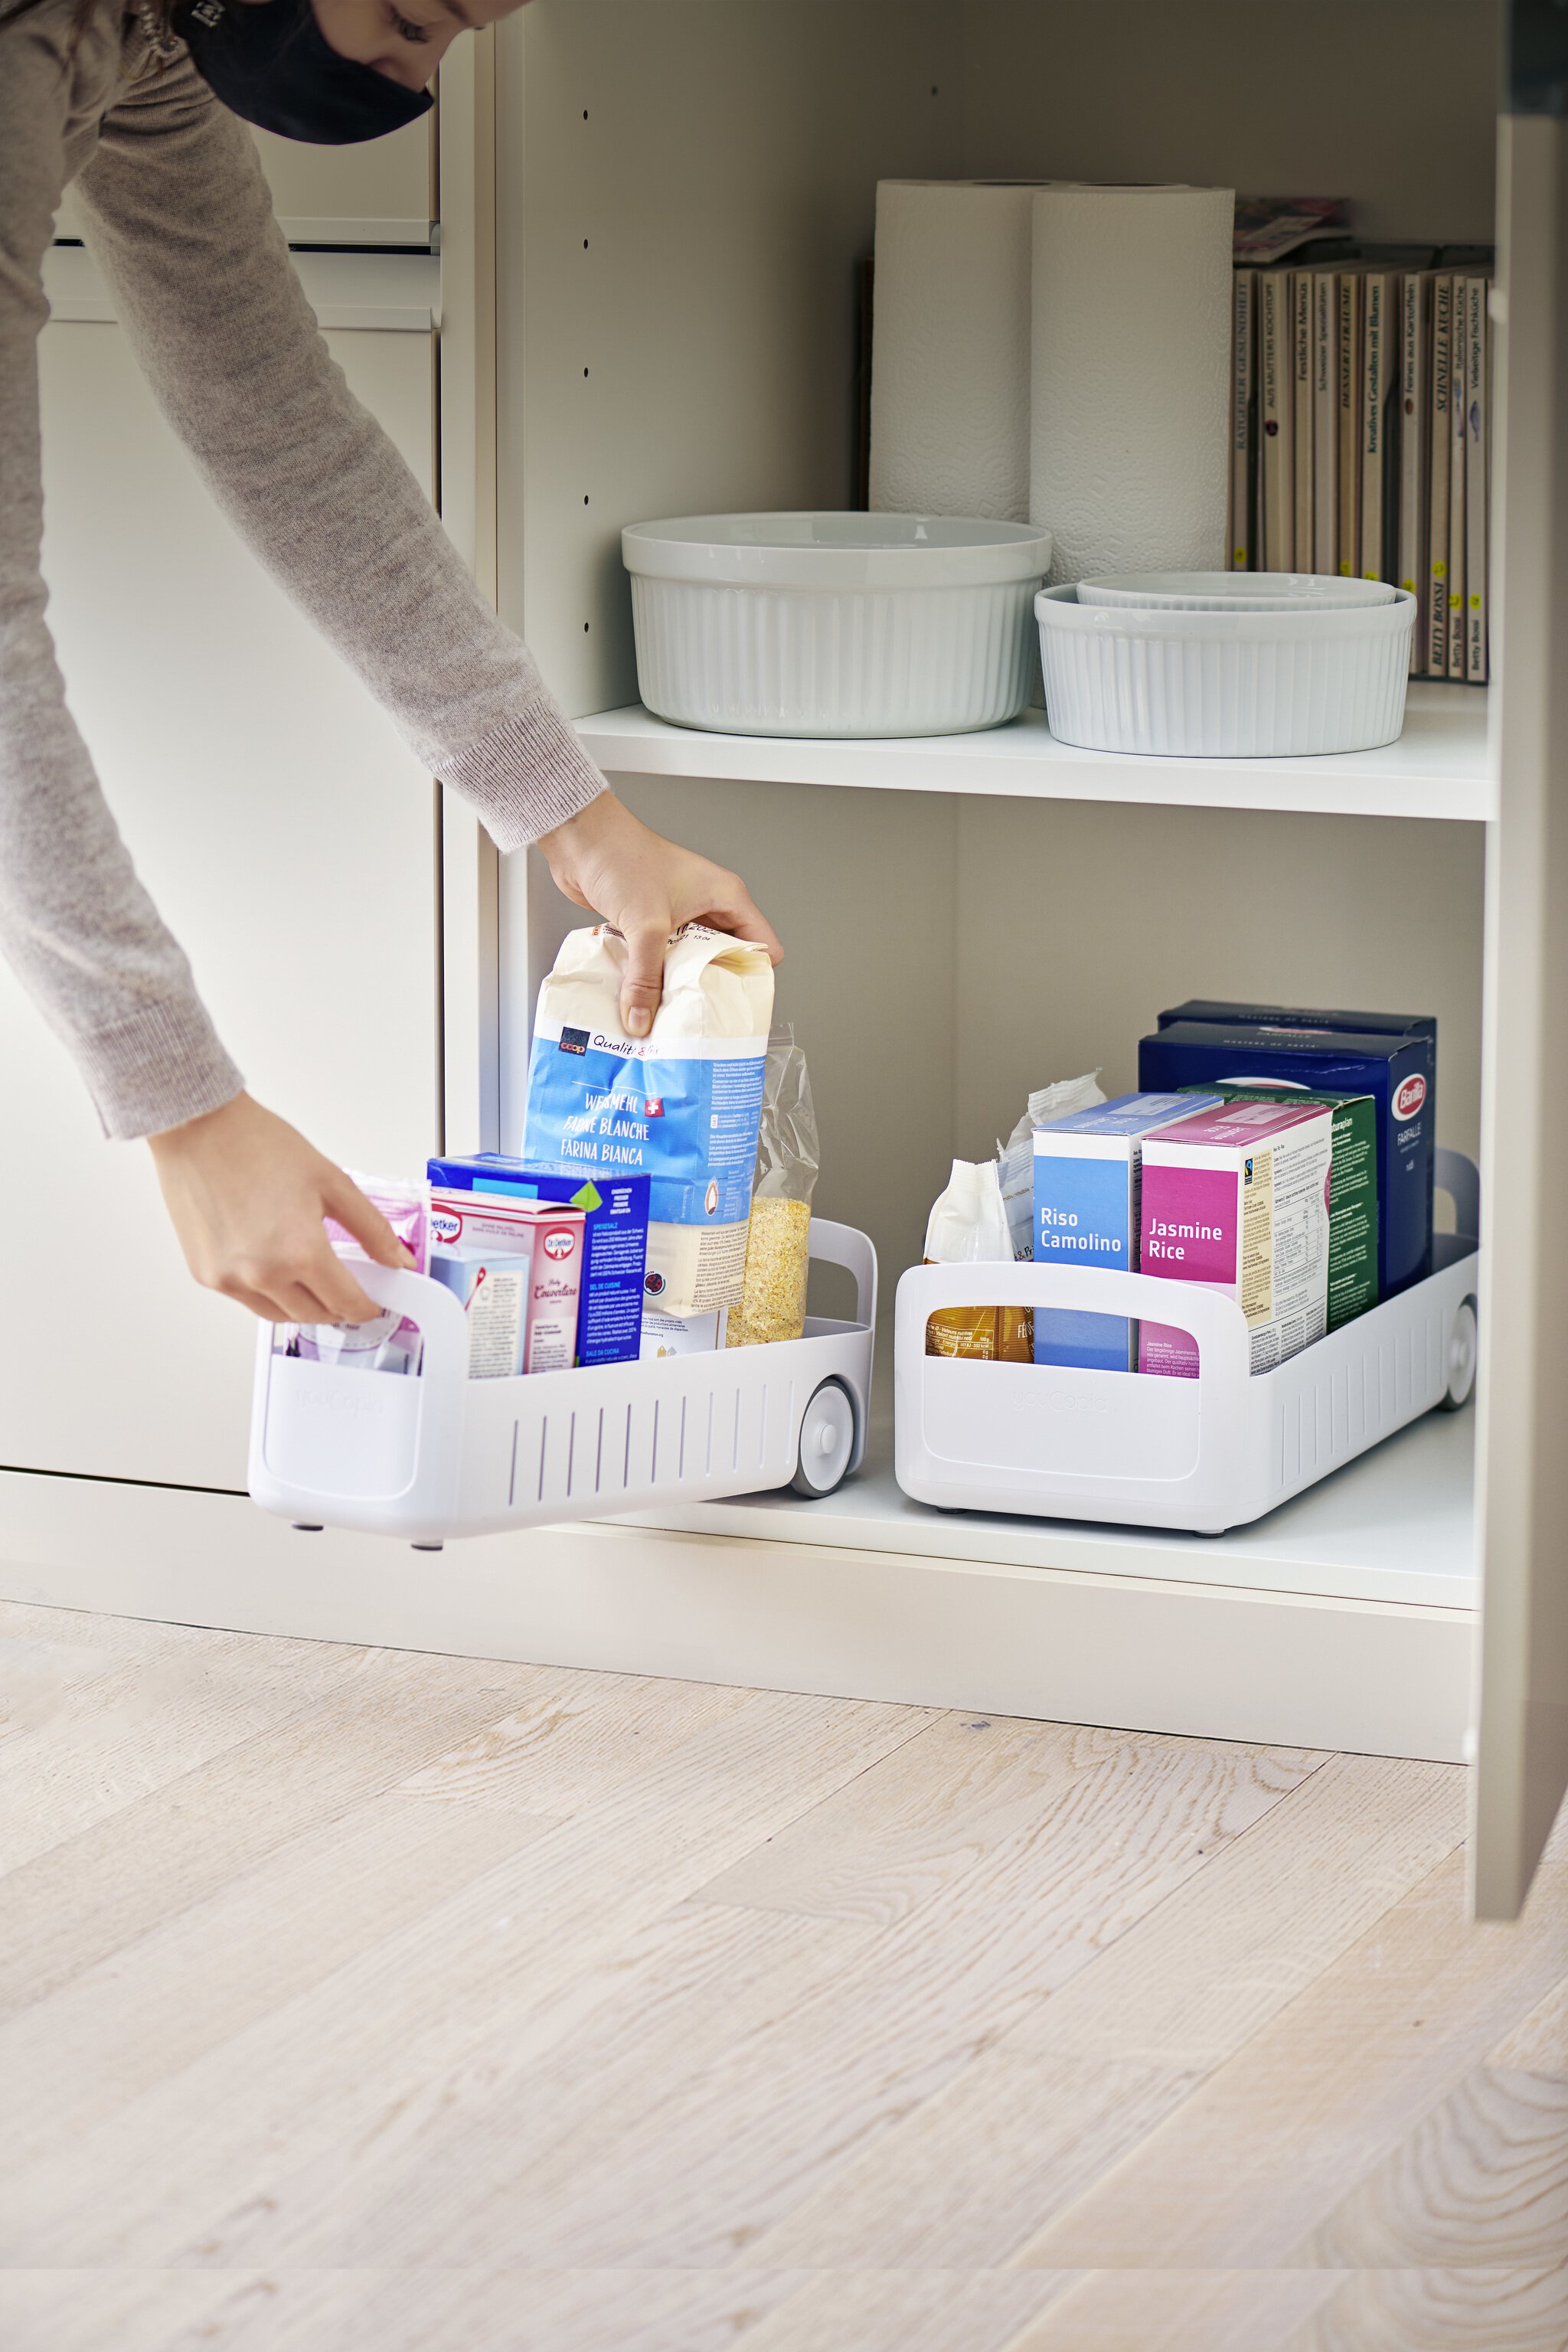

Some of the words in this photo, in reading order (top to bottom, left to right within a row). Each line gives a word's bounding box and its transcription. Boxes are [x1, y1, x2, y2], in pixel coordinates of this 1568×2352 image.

[1265, 283, 1274, 335] KOCHTOPF
[1298, 283, 1308, 325] Menüs
[1368, 286, 1380, 327] Blumen
[1455, 286, 1465, 315] Küche
[1471, 287, 1480, 338] Fischküche
[1236, 283, 1247, 373] GESUNDHEIT
[1368, 331, 1379, 348] mit
[1298, 329, 1308, 381] Festliche
[1455, 318, 1465, 370] Italienische
[1266, 338, 1274, 385] MUTTERS
[1318, 345, 1327, 391] Schweizer
[1436, 339, 1449, 412] SCHNELLE
[1470, 341, 1481, 389] Vielseitige
[1367, 351, 1379, 402] Gestalten
[1405, 361, 1415, 393] Feines
[1266, 388, 1275, 408] AUS
[1236, 377, 1247, 449] RATGEBER
[1367, 404, 1379, 453] Kreatives
[1432, 582, 1445, 622] BOSSI
[1452, 617, 1461, 640] Bossi
[1472, 619, 1480, 643] Bossi
[1432, 624, 1444, 666] BETTY
[1452, 643, 1463, 668] Betty
[1471, 645, 1481, 671] Betty
[560, 1042, 585, 1054] coop
[1400, 1081, 1424, 1109] Barilla
[599, 1118, 650, 1141] BLANCHE
[1397, 1122, 1422, 1146] FARFALLE
[561, 1138, 597, 1161] FARINA
[601, 1144, 642, 1166] BIANCA
[431, 1219, 458, 1230] etker
[1040, 1207, 1078, 1227] Riso
[1148, 1218, 1223, 1241] Jasmine
[1018, 1250, 1027, 1260] &
[1041, 1230, 1122, 1253] Camolino
[1148, 1240, 1184, 1260] Rice
[1012, 1390, 1109, 1416] youCopia
